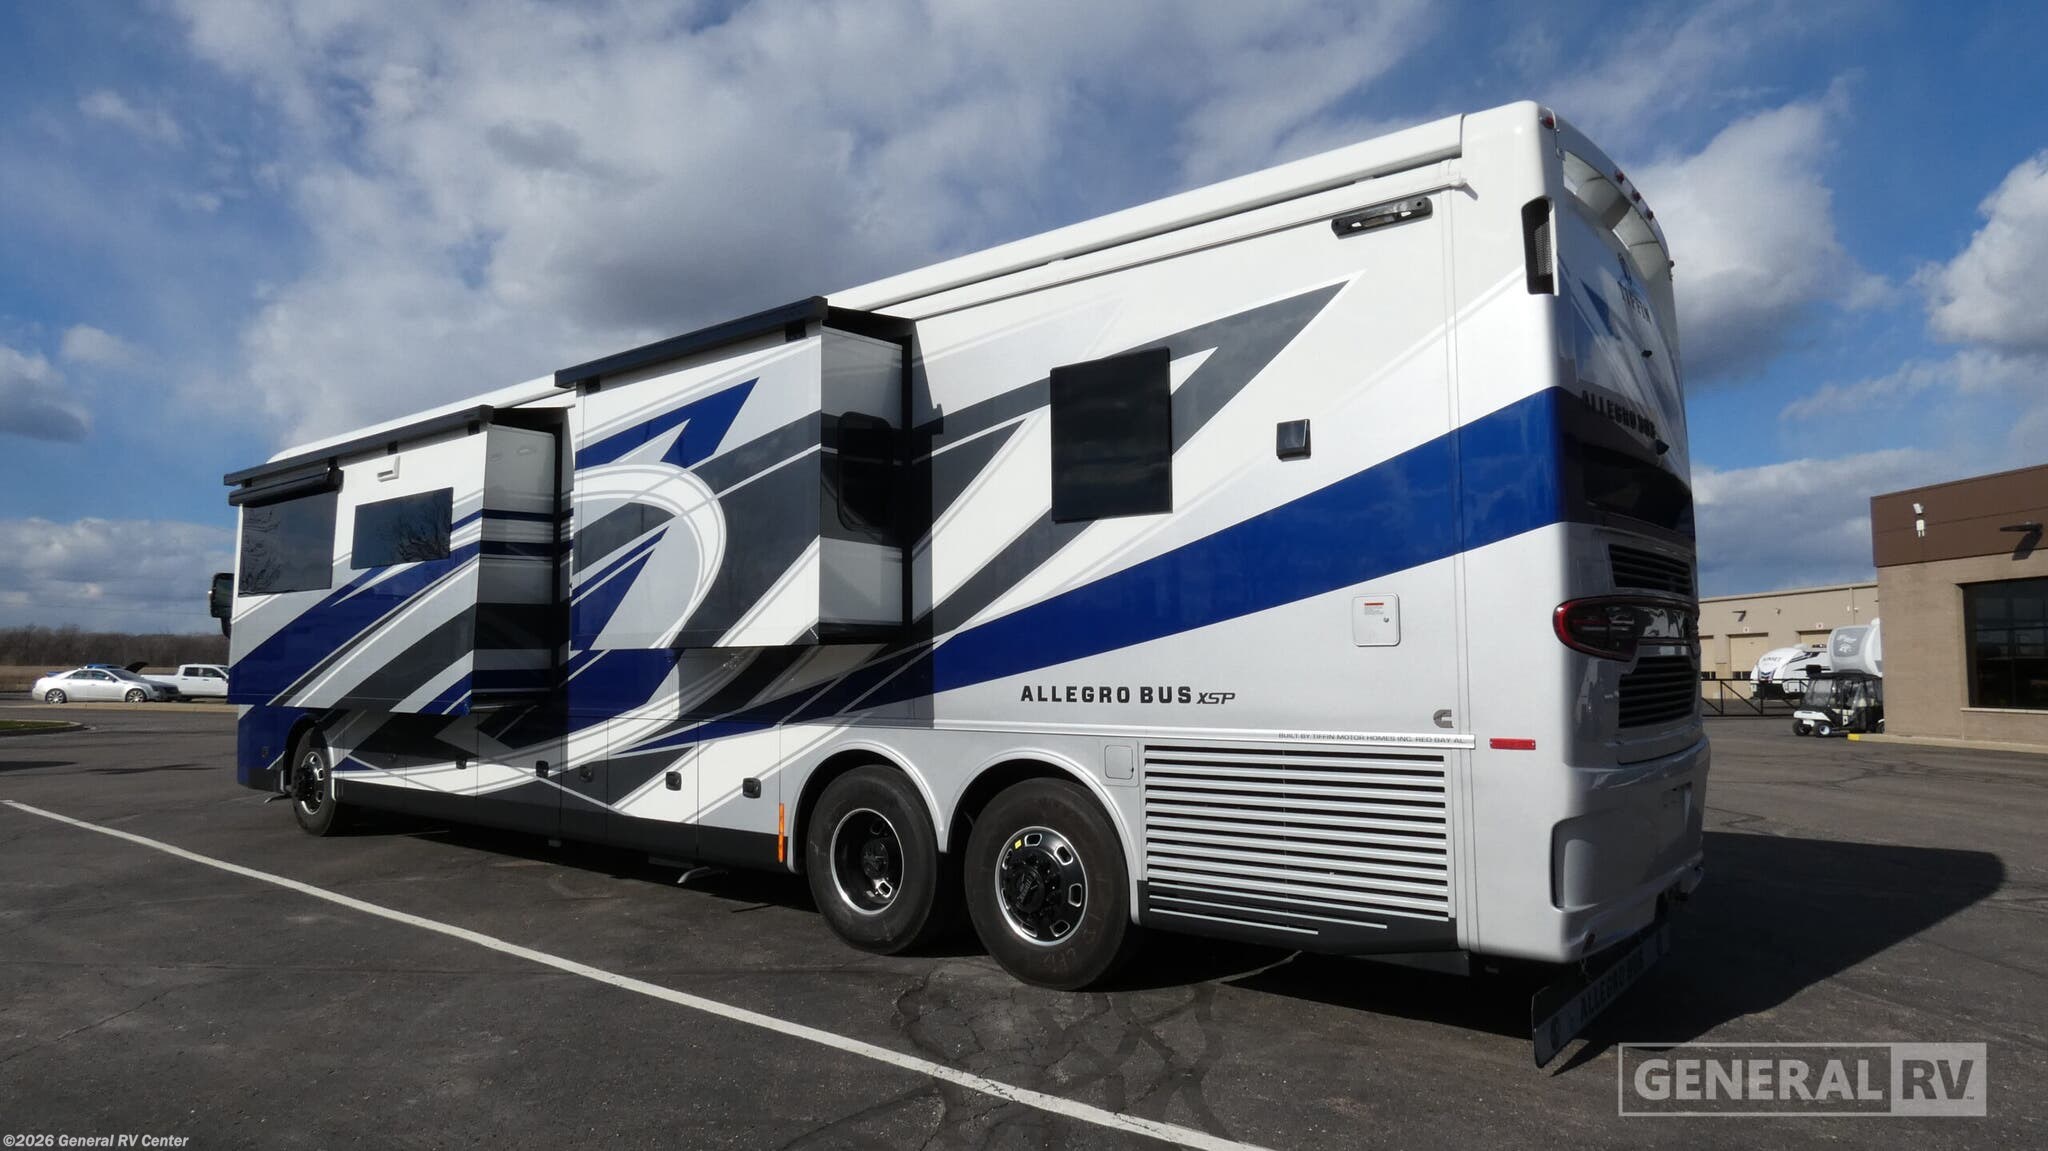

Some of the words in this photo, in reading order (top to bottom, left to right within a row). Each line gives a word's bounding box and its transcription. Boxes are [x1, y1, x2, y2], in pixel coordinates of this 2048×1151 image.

[1582, 390, 1636, 430] ALLEGRO
[1637, 413, 1656, 440] BUS
[1020, 685, 1131, 704] ALLEGRO
[1140, 686, 1191, 704] BUS
[1196, 692, 1236, 705] XSP
